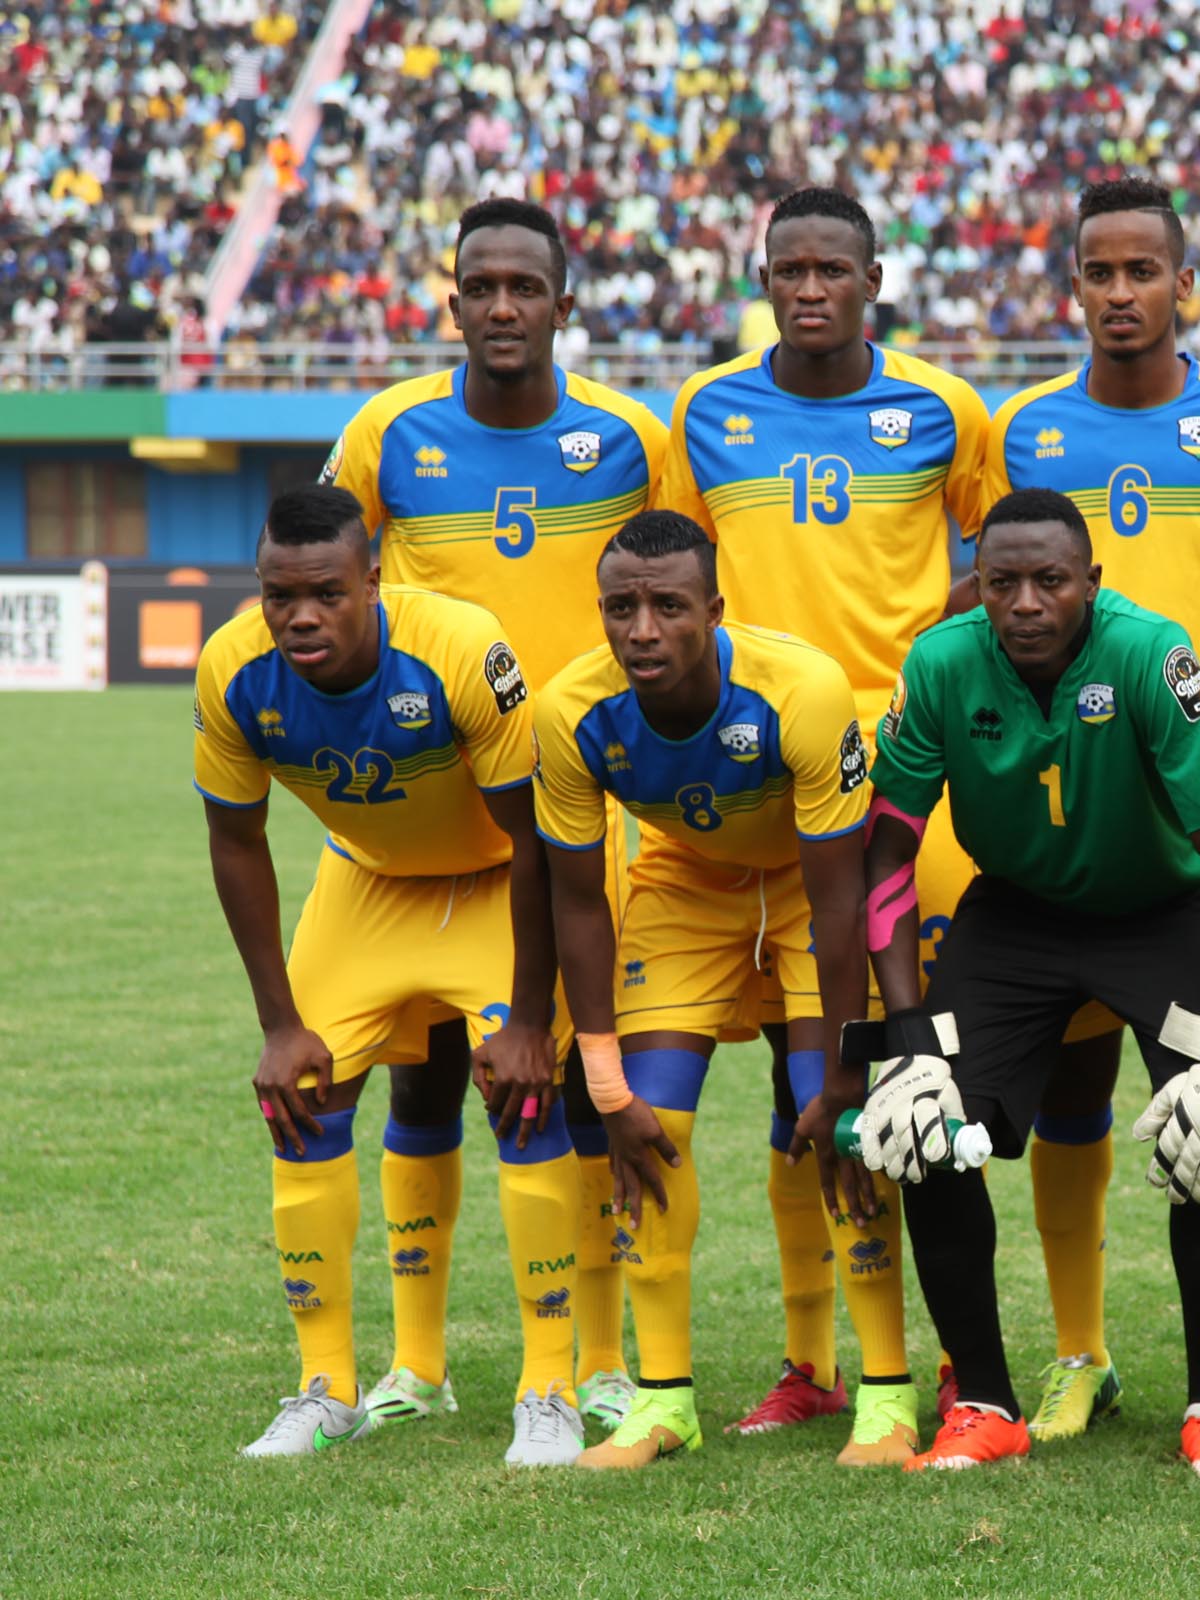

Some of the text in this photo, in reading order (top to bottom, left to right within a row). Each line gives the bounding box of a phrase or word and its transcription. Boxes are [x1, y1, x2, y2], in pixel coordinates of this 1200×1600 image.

[780, 453, 854, 525] 13
[1108, 464, 1152, 538] 6
[493, 486, 537, 559] 5
[312, 746, 407, 805] 22
[1038, 763, 1067, 827] 1
[675, 782, 723, 832] 8
[279, 1250, 324, 1264] WA
[528, 1253, 576, 1275] RWA
